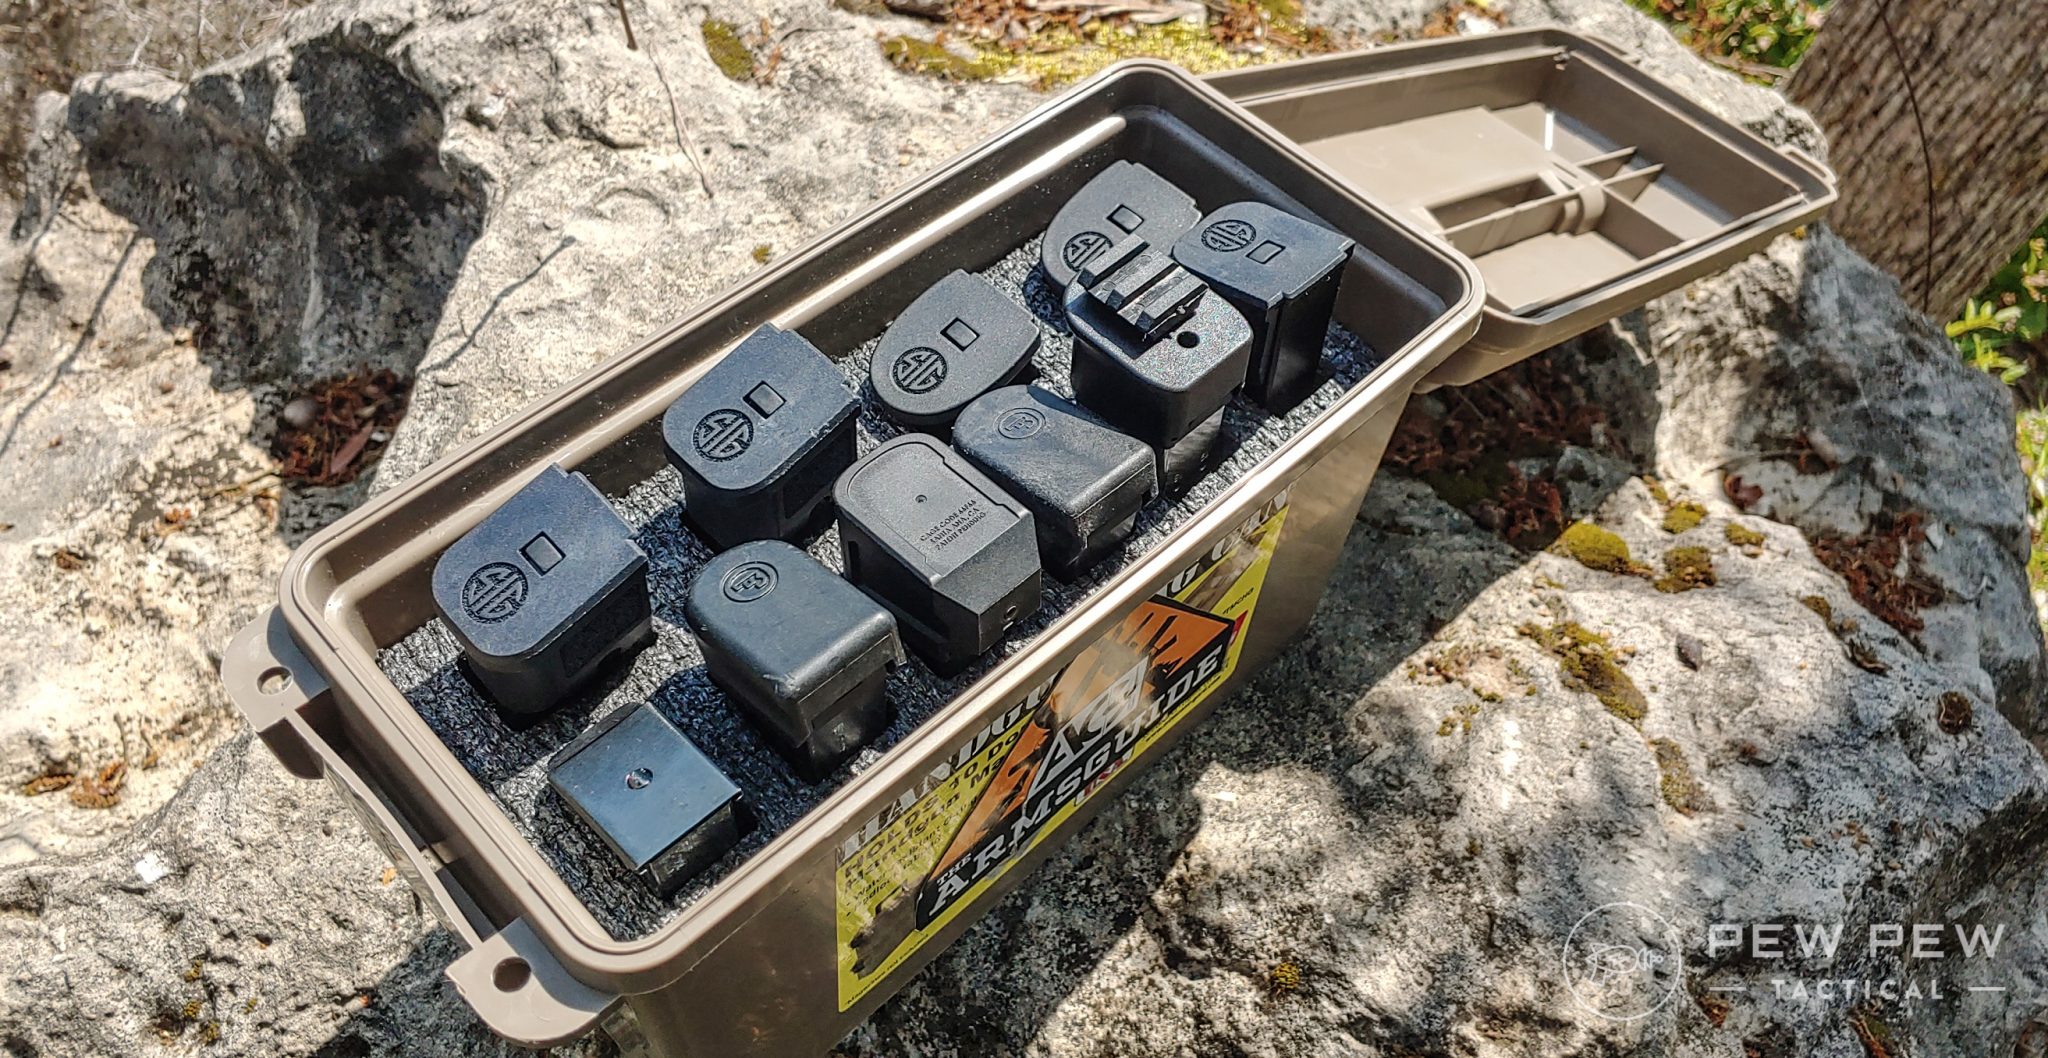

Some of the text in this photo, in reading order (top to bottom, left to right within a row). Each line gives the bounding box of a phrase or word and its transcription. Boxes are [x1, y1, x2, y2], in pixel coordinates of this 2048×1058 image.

[1064, 232, 1113, 272] SI
[928, 645, 1222, 916] ARMSGUIDE
[937, 853, 972, 883] THE
